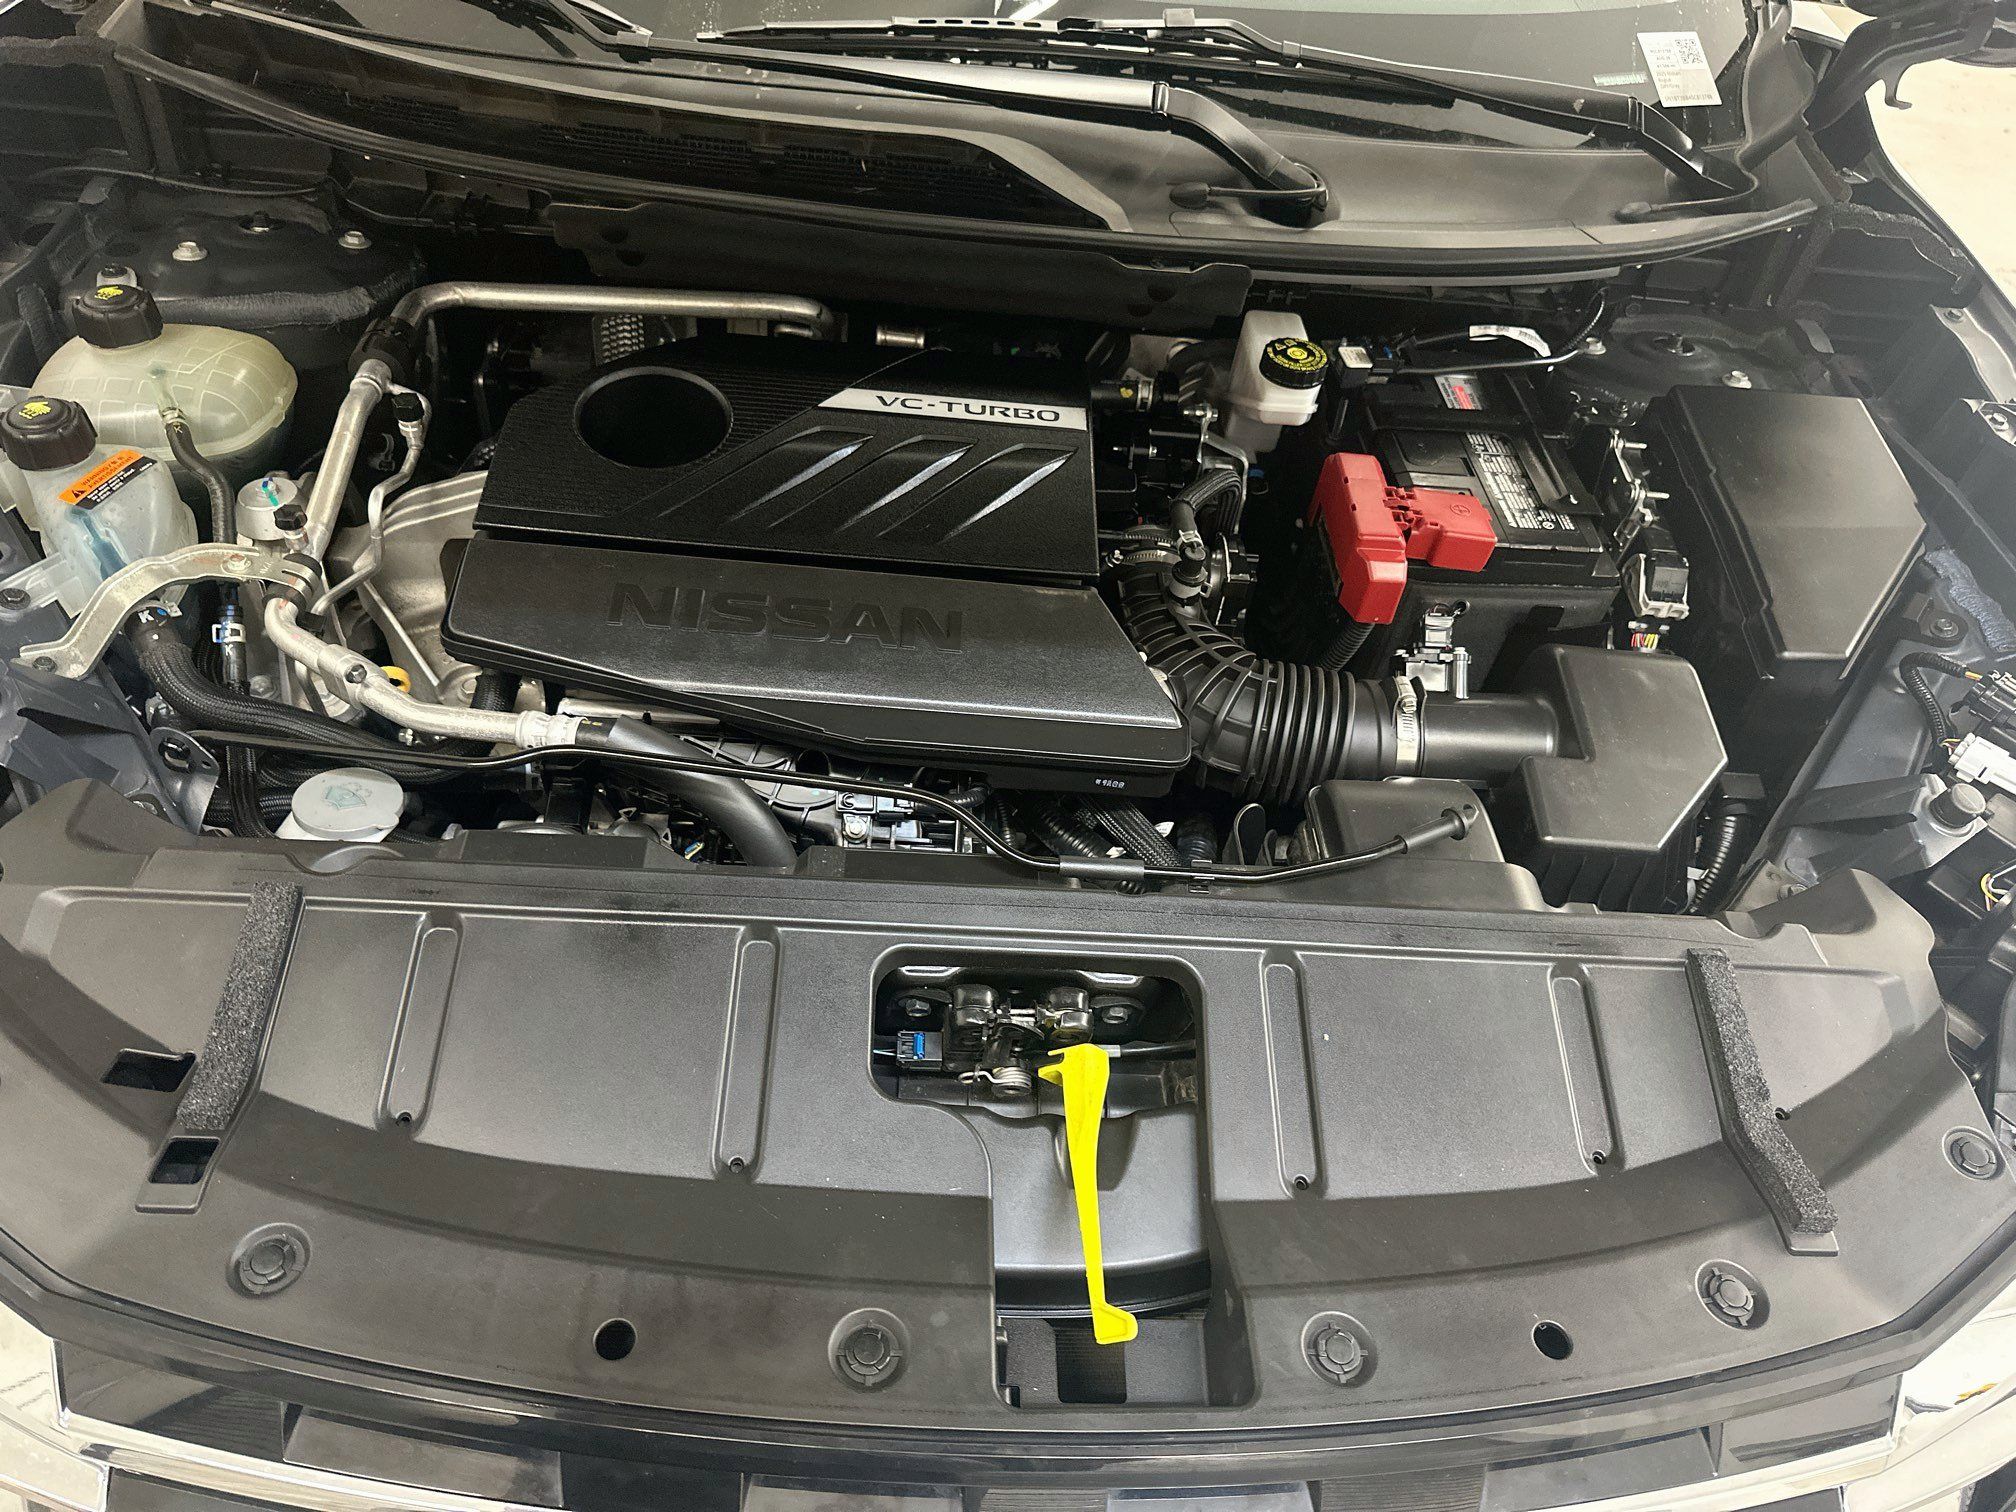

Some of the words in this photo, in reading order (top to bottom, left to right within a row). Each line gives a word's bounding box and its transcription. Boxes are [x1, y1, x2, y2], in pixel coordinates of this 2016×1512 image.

[875, 395, 1060, 422] VC-TURBO
[138, 609, 155, 624] K
[606, 582, 964, 655] NISSAN
[224, 644, 234, 656] K
